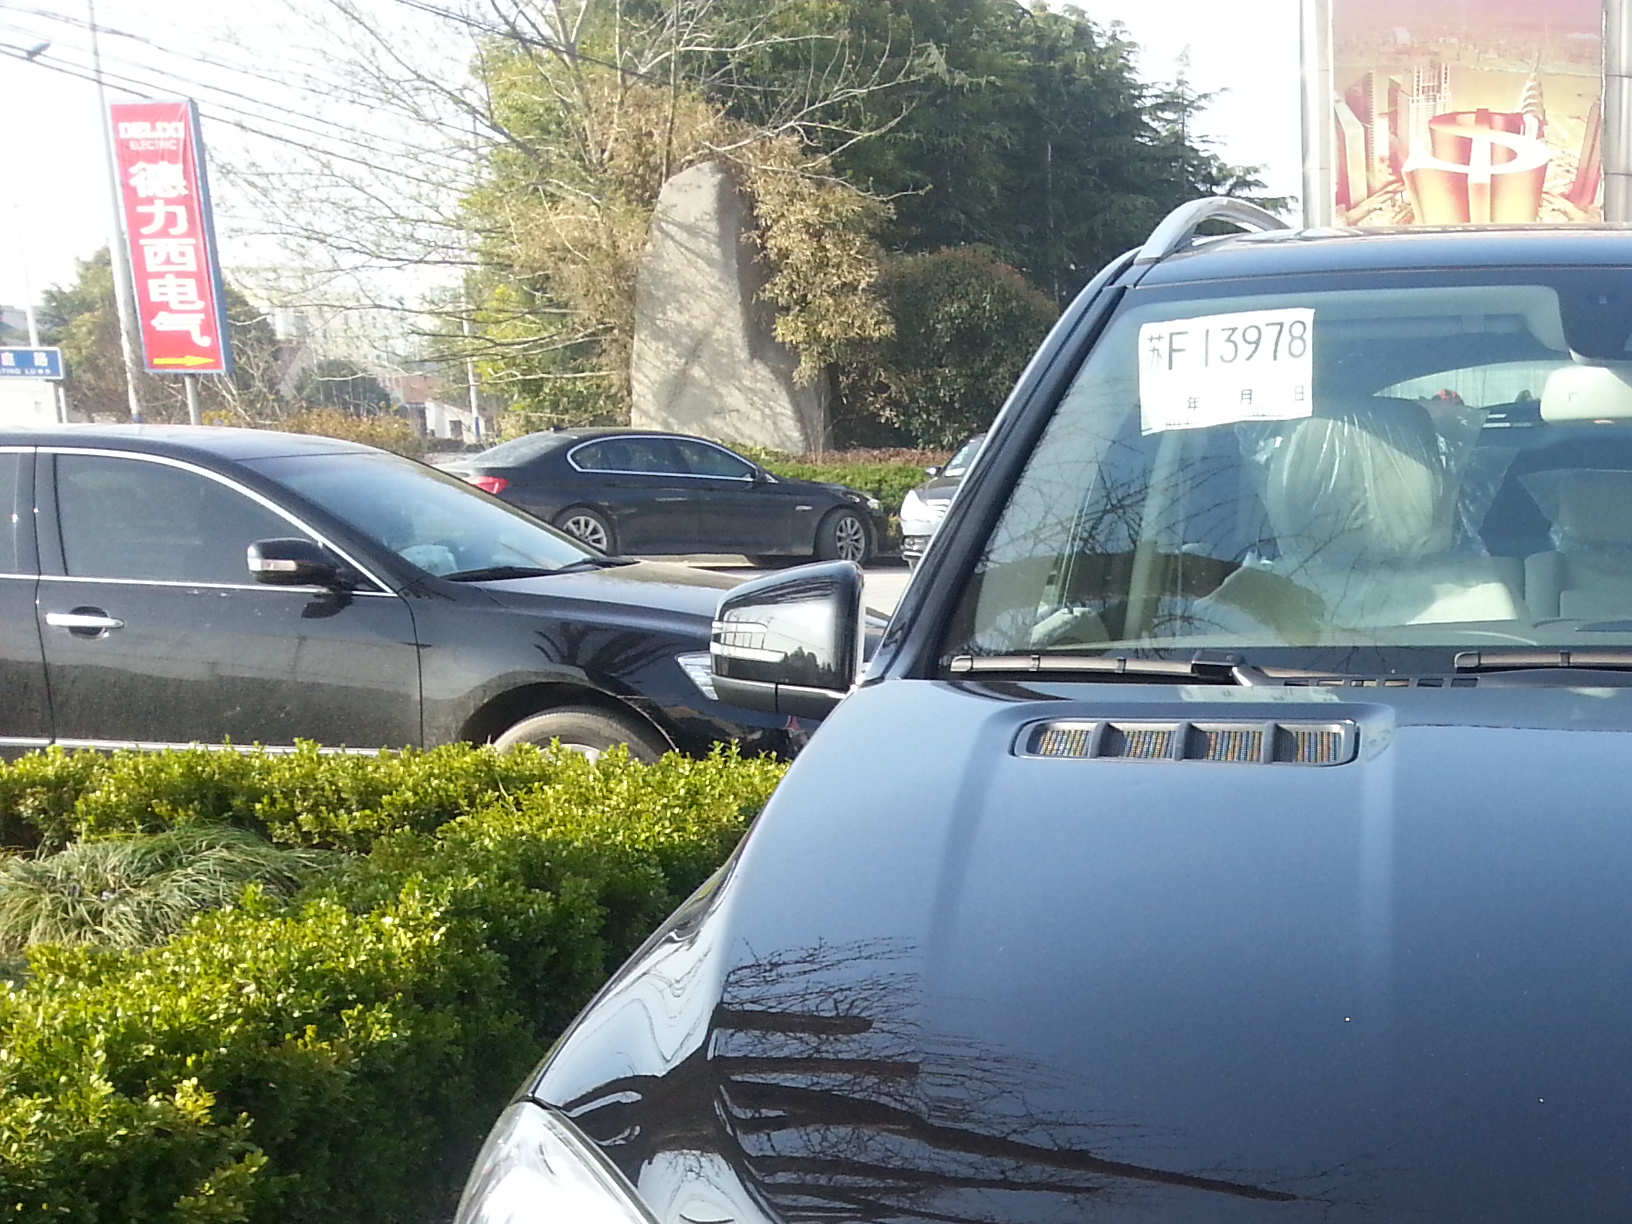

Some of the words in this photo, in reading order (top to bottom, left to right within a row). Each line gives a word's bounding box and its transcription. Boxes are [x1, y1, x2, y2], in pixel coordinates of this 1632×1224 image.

[129, 140, 178, 151] ELECTRIC
[129, 161, 212, 347] 德力西电气
[1240, 388, 1253, 404] 月
[1294, 385, 1304, 401] 日
